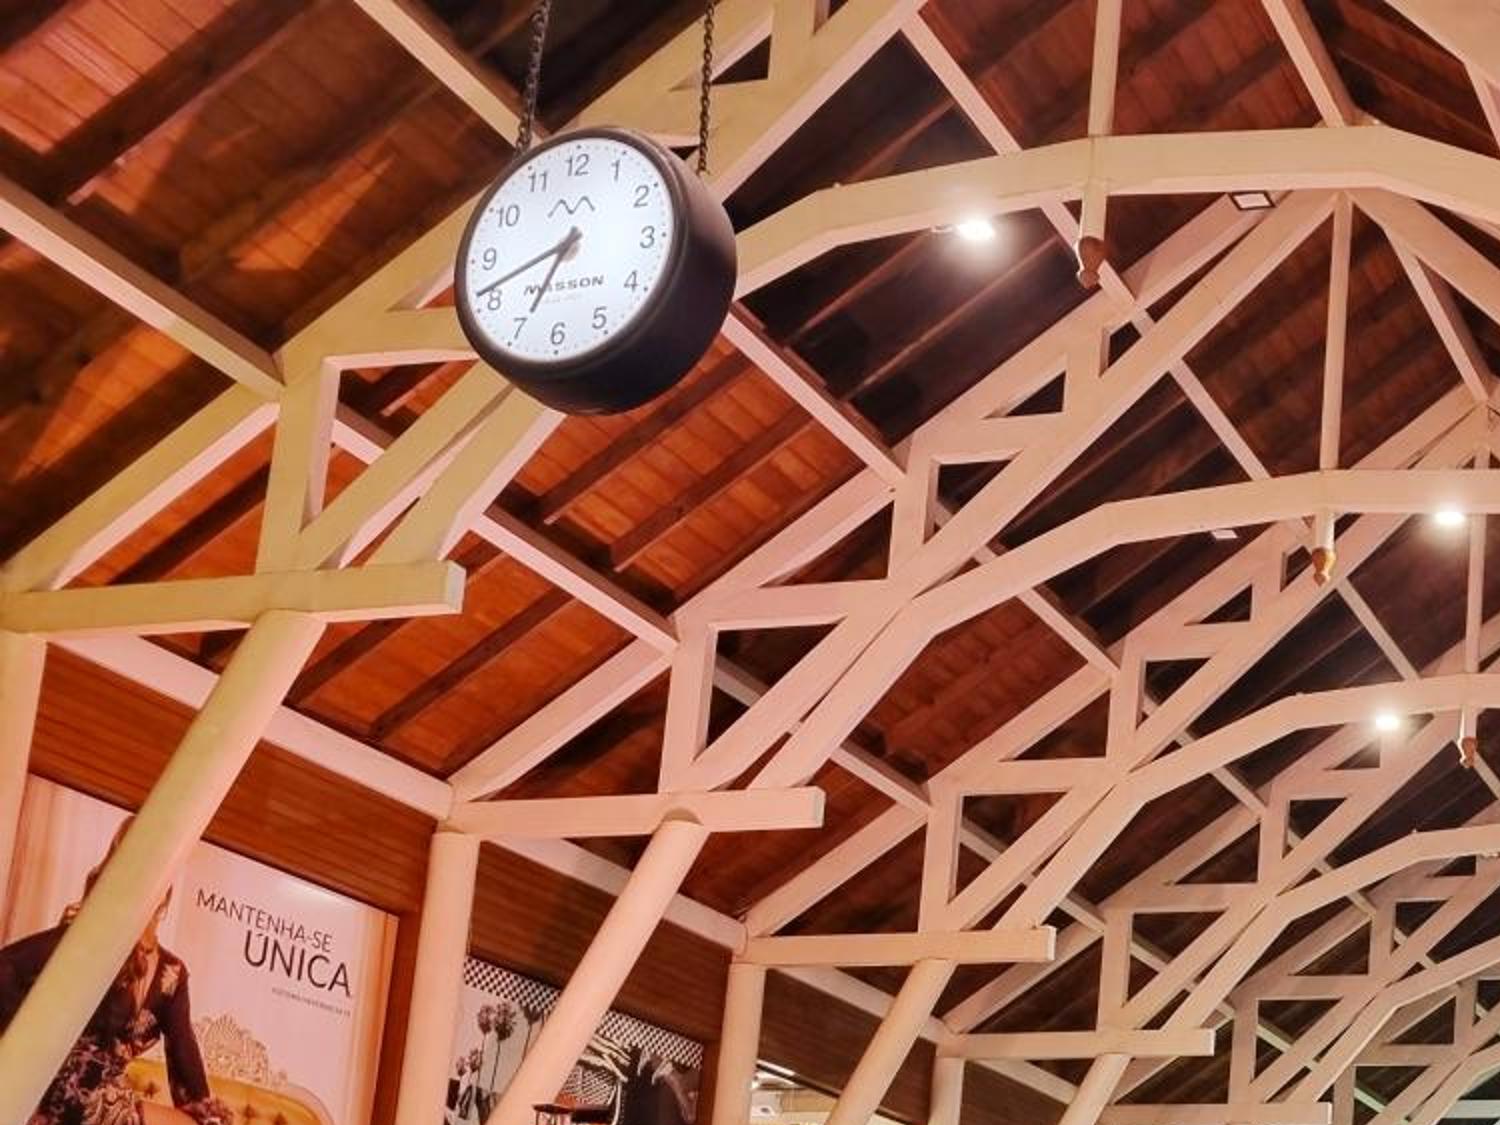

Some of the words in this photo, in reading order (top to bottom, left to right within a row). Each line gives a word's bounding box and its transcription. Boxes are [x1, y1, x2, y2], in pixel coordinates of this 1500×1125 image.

[565, 153, 590, 177] 12
[611, 159, 623, 182] 1
[528, 171, 548, 193] 11
[633, 185, 651, 209] 2
[498, 204, 521, 227] 10
[640, 226, 656, 249] 3
[483, 247, 497, 271] 9
[623, 271, 638, 293] 4
[486, 287, 503, 311] 8
[513, 317, 528, 341] 7
[592, 306, 608, 329] 5
[550, 322, 565, 345] 6
[197, 889, 332, 952] MANTENHA-SE
[244, 929, 352, 998] ÚNICA
